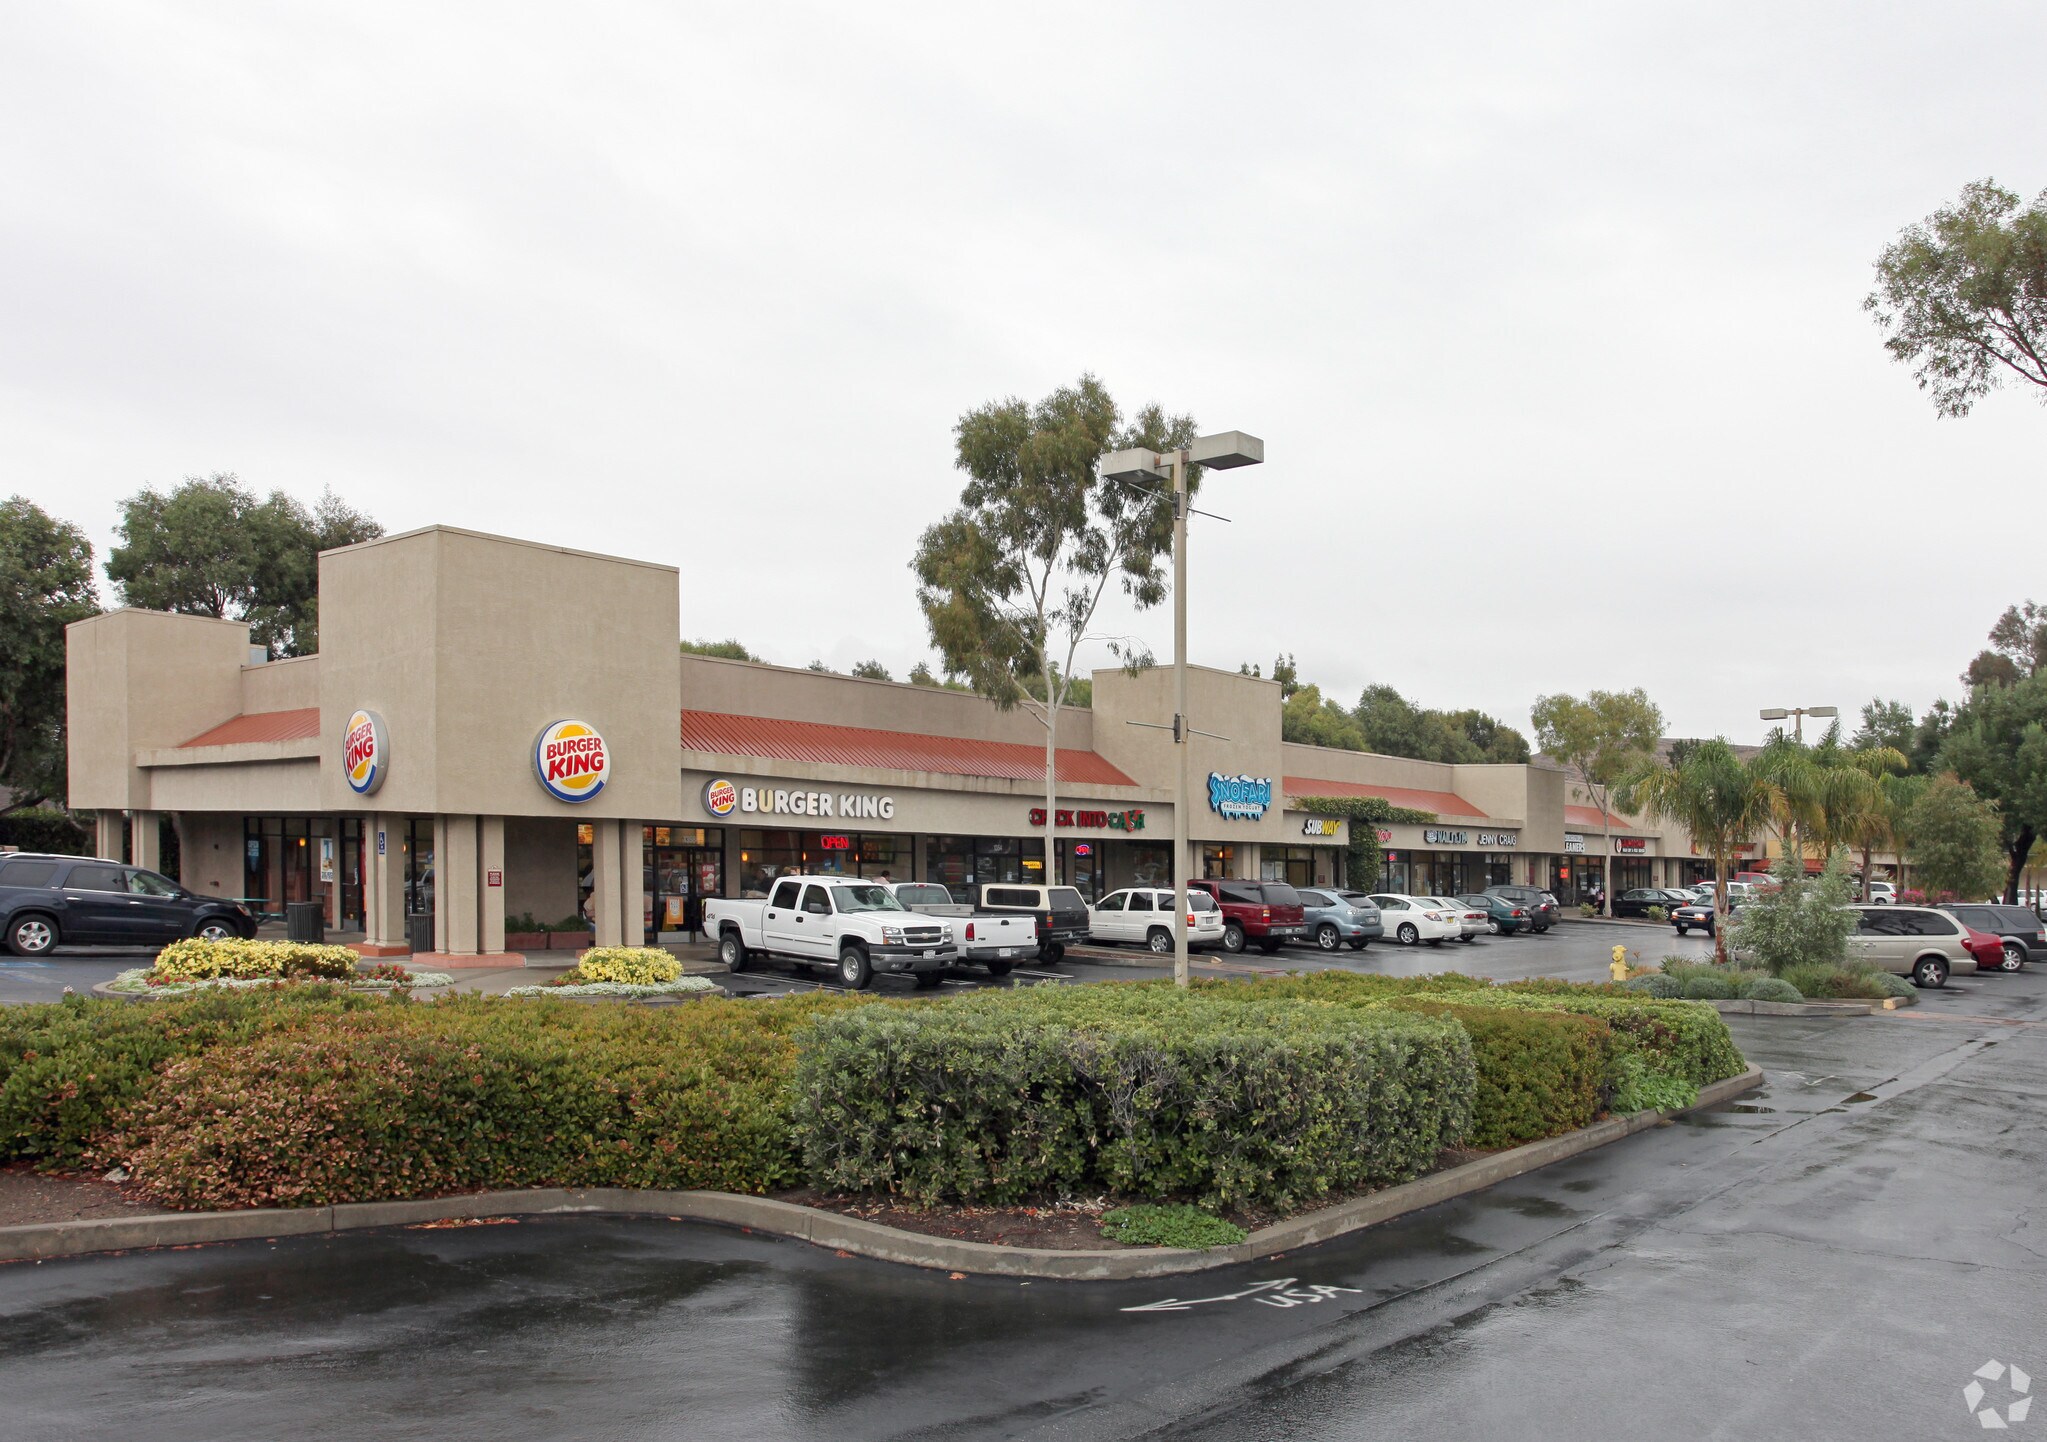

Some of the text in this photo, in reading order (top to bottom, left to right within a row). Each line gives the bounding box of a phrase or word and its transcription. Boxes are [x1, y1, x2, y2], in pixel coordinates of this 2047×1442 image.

[346, 736, 374, 777] KING
[547, 737, 602, 760] BURGER
[548, 751, 604, 781] KING
[710, 786, 734, 800] BURGER
[1209, 774, 1272, 805] SNOFARI
[711, 793, 735, 809] KING
[742, 787, 894, 819] BURGER KING
[1077, 811, 1107, 828] INTO
[1304, 819, 1341, 836] SUBWAY
[821, 836, 849, 849] OPEN
[1479, 834, 1517, 846] JENNY CRAIG
[1254, 1284, 1363, 1308] USA
